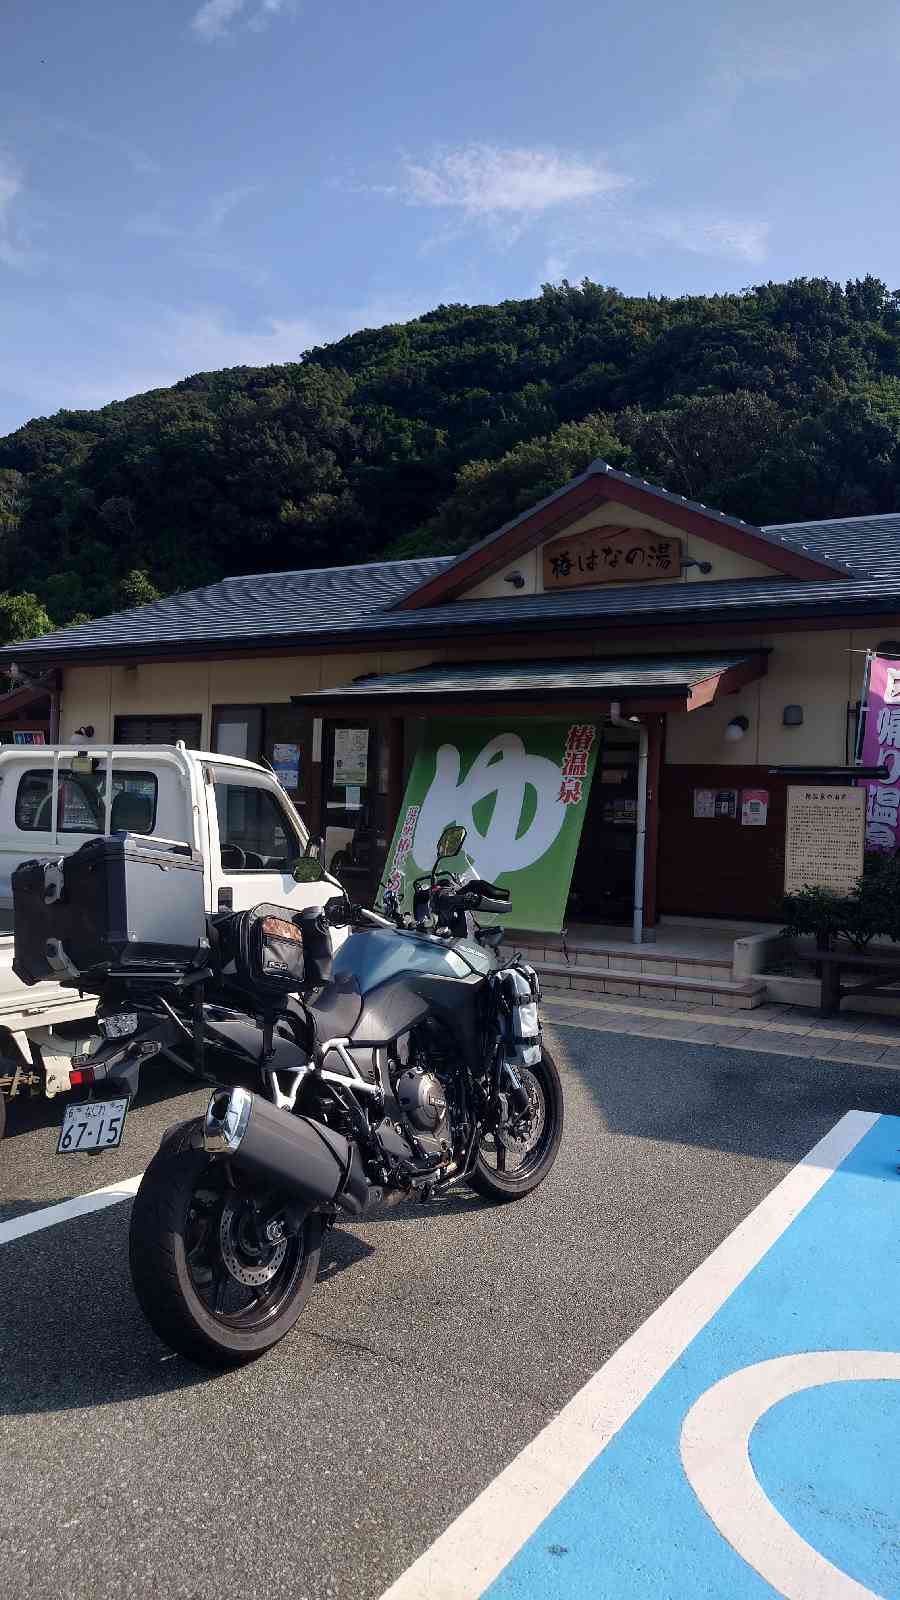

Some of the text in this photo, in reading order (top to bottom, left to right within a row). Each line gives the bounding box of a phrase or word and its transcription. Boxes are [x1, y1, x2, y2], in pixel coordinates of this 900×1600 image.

[549, 543, 675, 580] 椿はなの湯
[560, 724, 597, 806] 椿温泉
[411, 732, 567, 883] ゆ
[61, 1117, 121, 1149] 67-15
